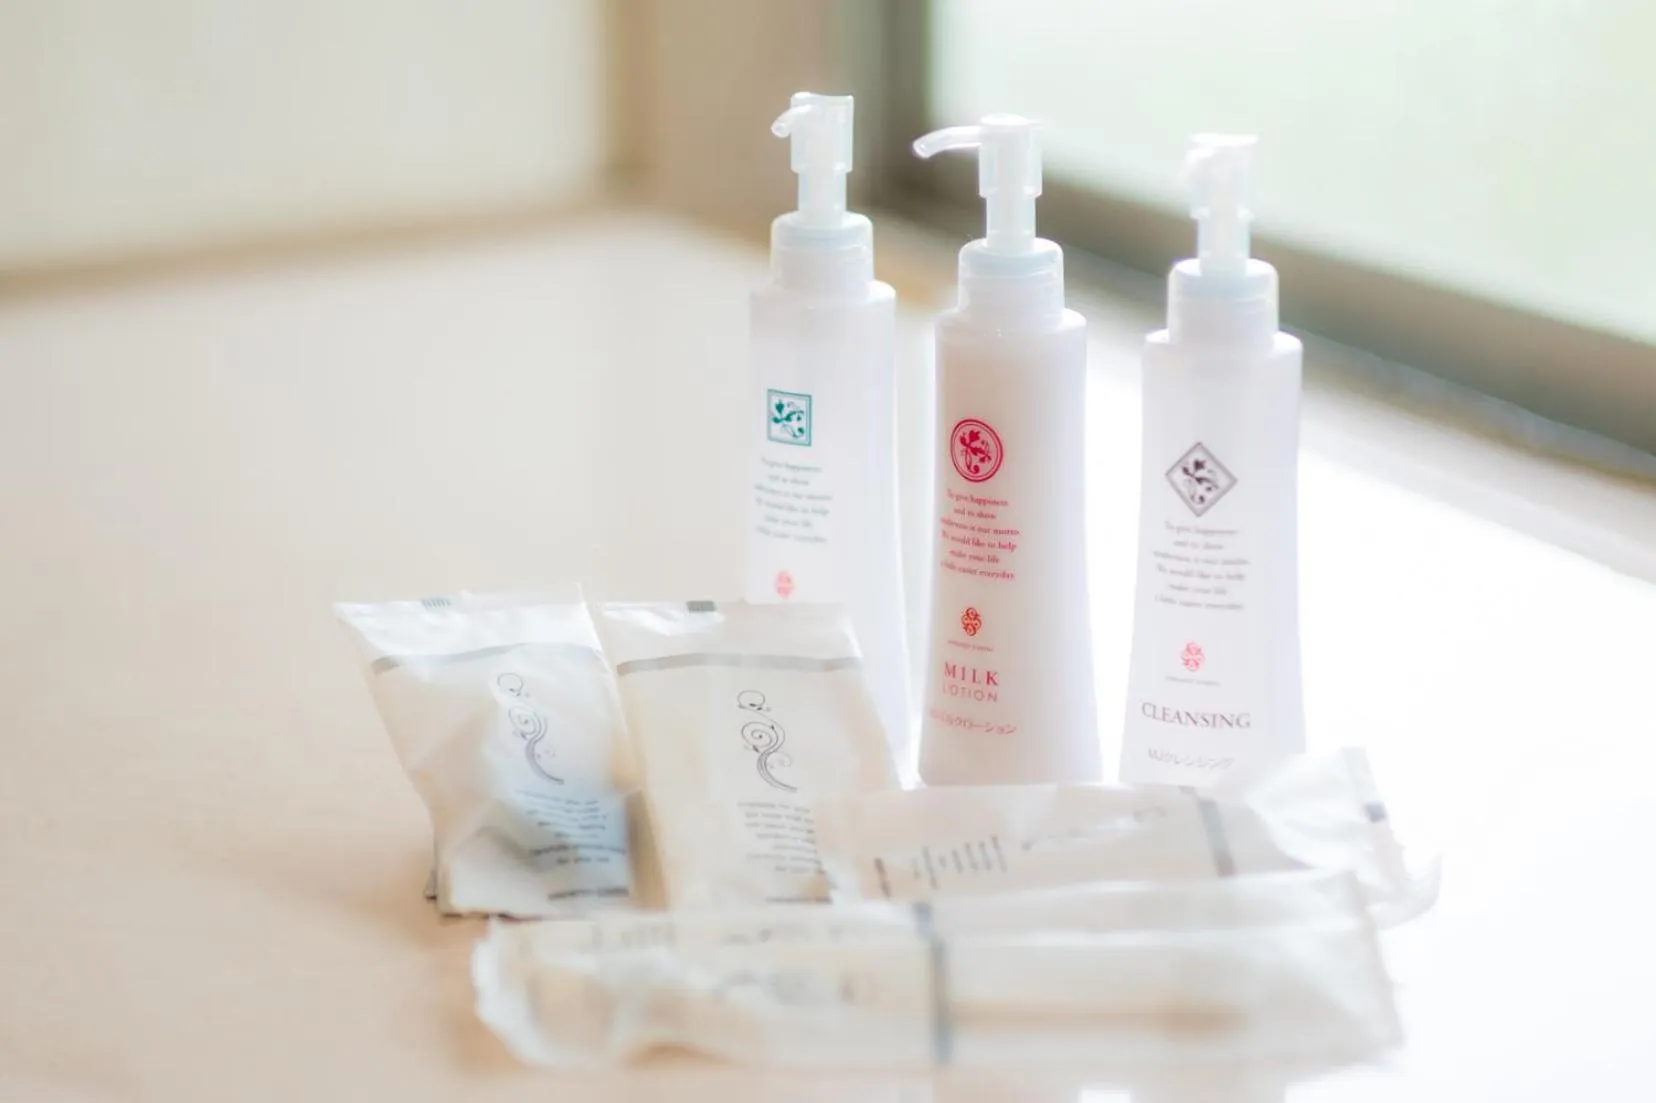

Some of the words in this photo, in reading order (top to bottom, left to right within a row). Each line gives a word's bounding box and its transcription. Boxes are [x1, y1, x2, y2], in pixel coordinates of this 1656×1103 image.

[998, 541, 1017, 553] help
[944, 661, 998, 686] MILK
[942, 682, 998, 704] LOTION
[1141, 701, 1252, 729] CLEANSING
